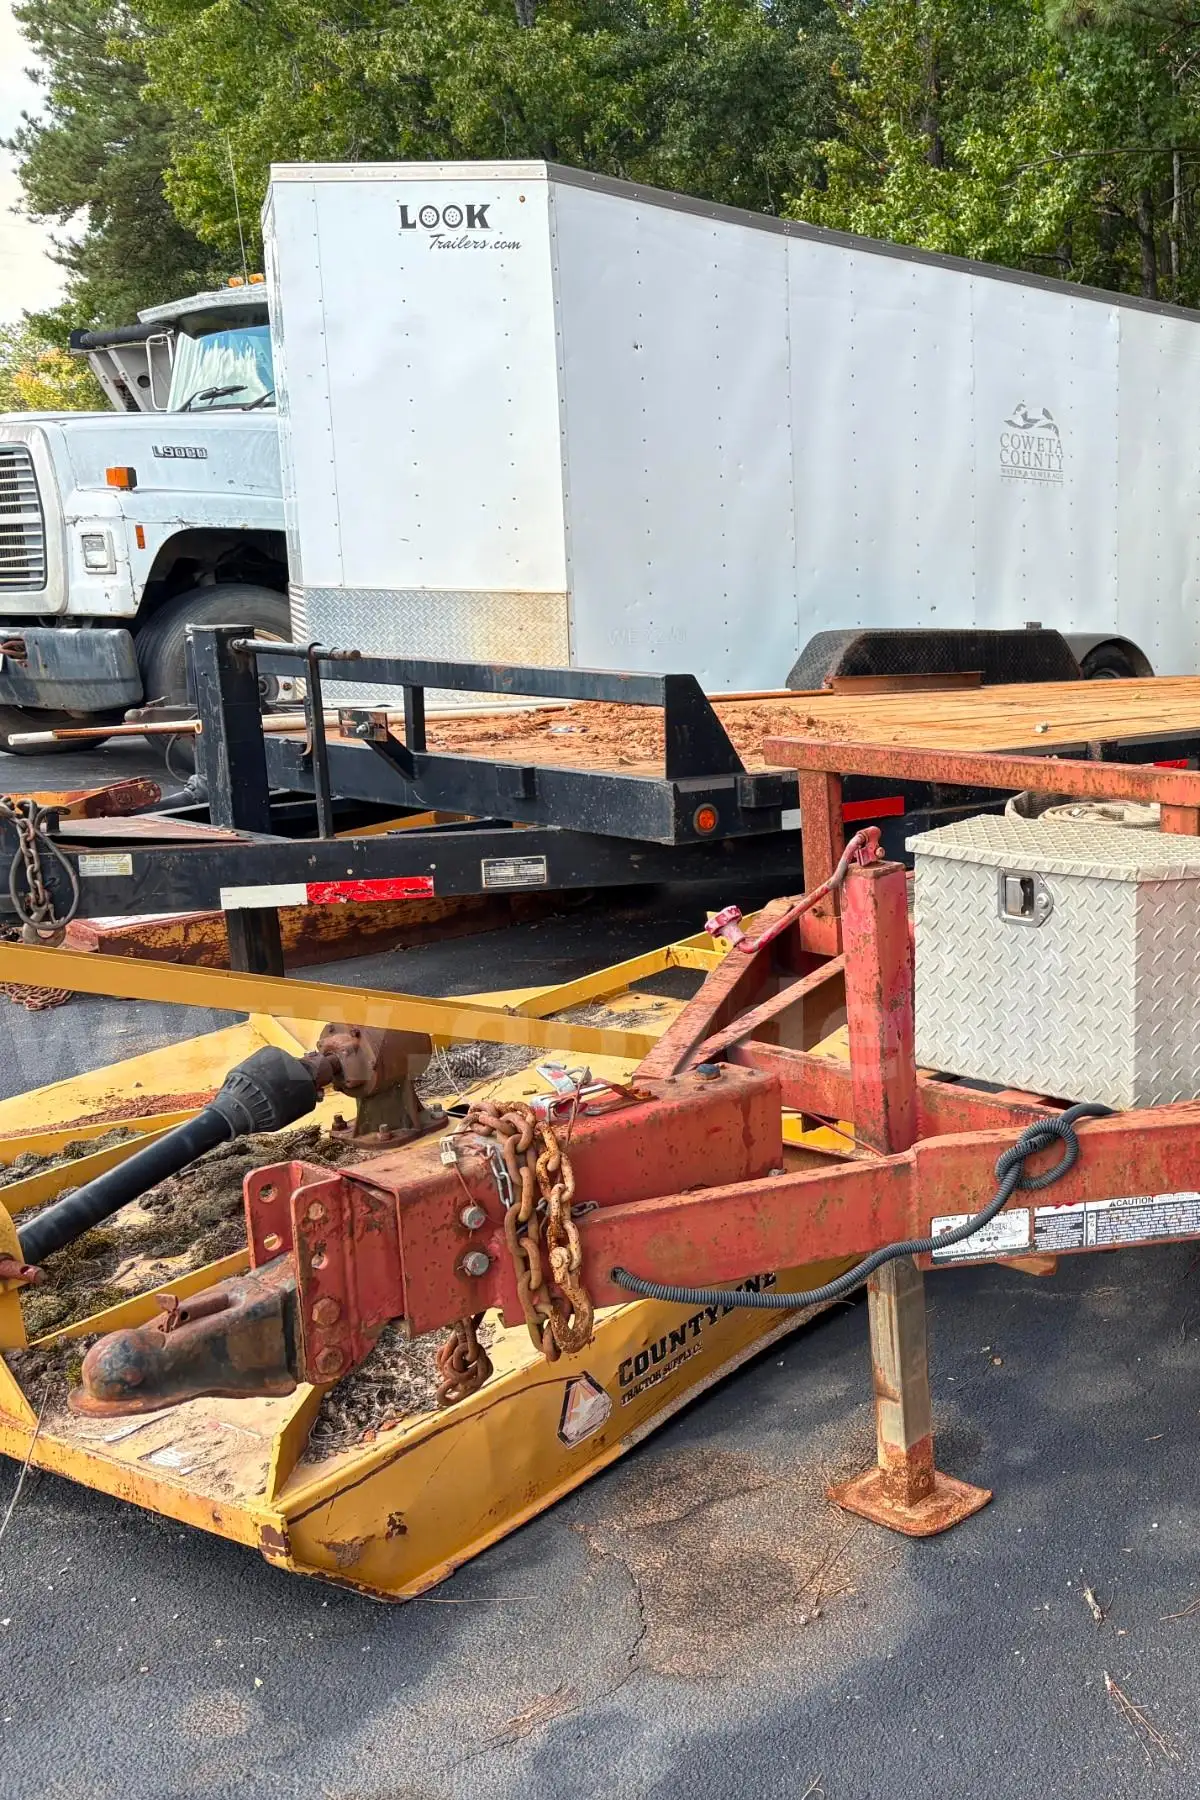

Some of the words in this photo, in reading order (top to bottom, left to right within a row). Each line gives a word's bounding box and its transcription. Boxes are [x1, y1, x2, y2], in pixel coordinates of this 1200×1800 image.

[398, 204, 491, 229] LOOK
[429, 233, 522, 250] Trailers.com
[1000, 432, 1063, 455] COWETA
[1000, 448, 1064, 470] COUNTY
[1116, 1196, 1154, 1207] CAUTION
[621, 1370, 662, 1406] TRACTOR
